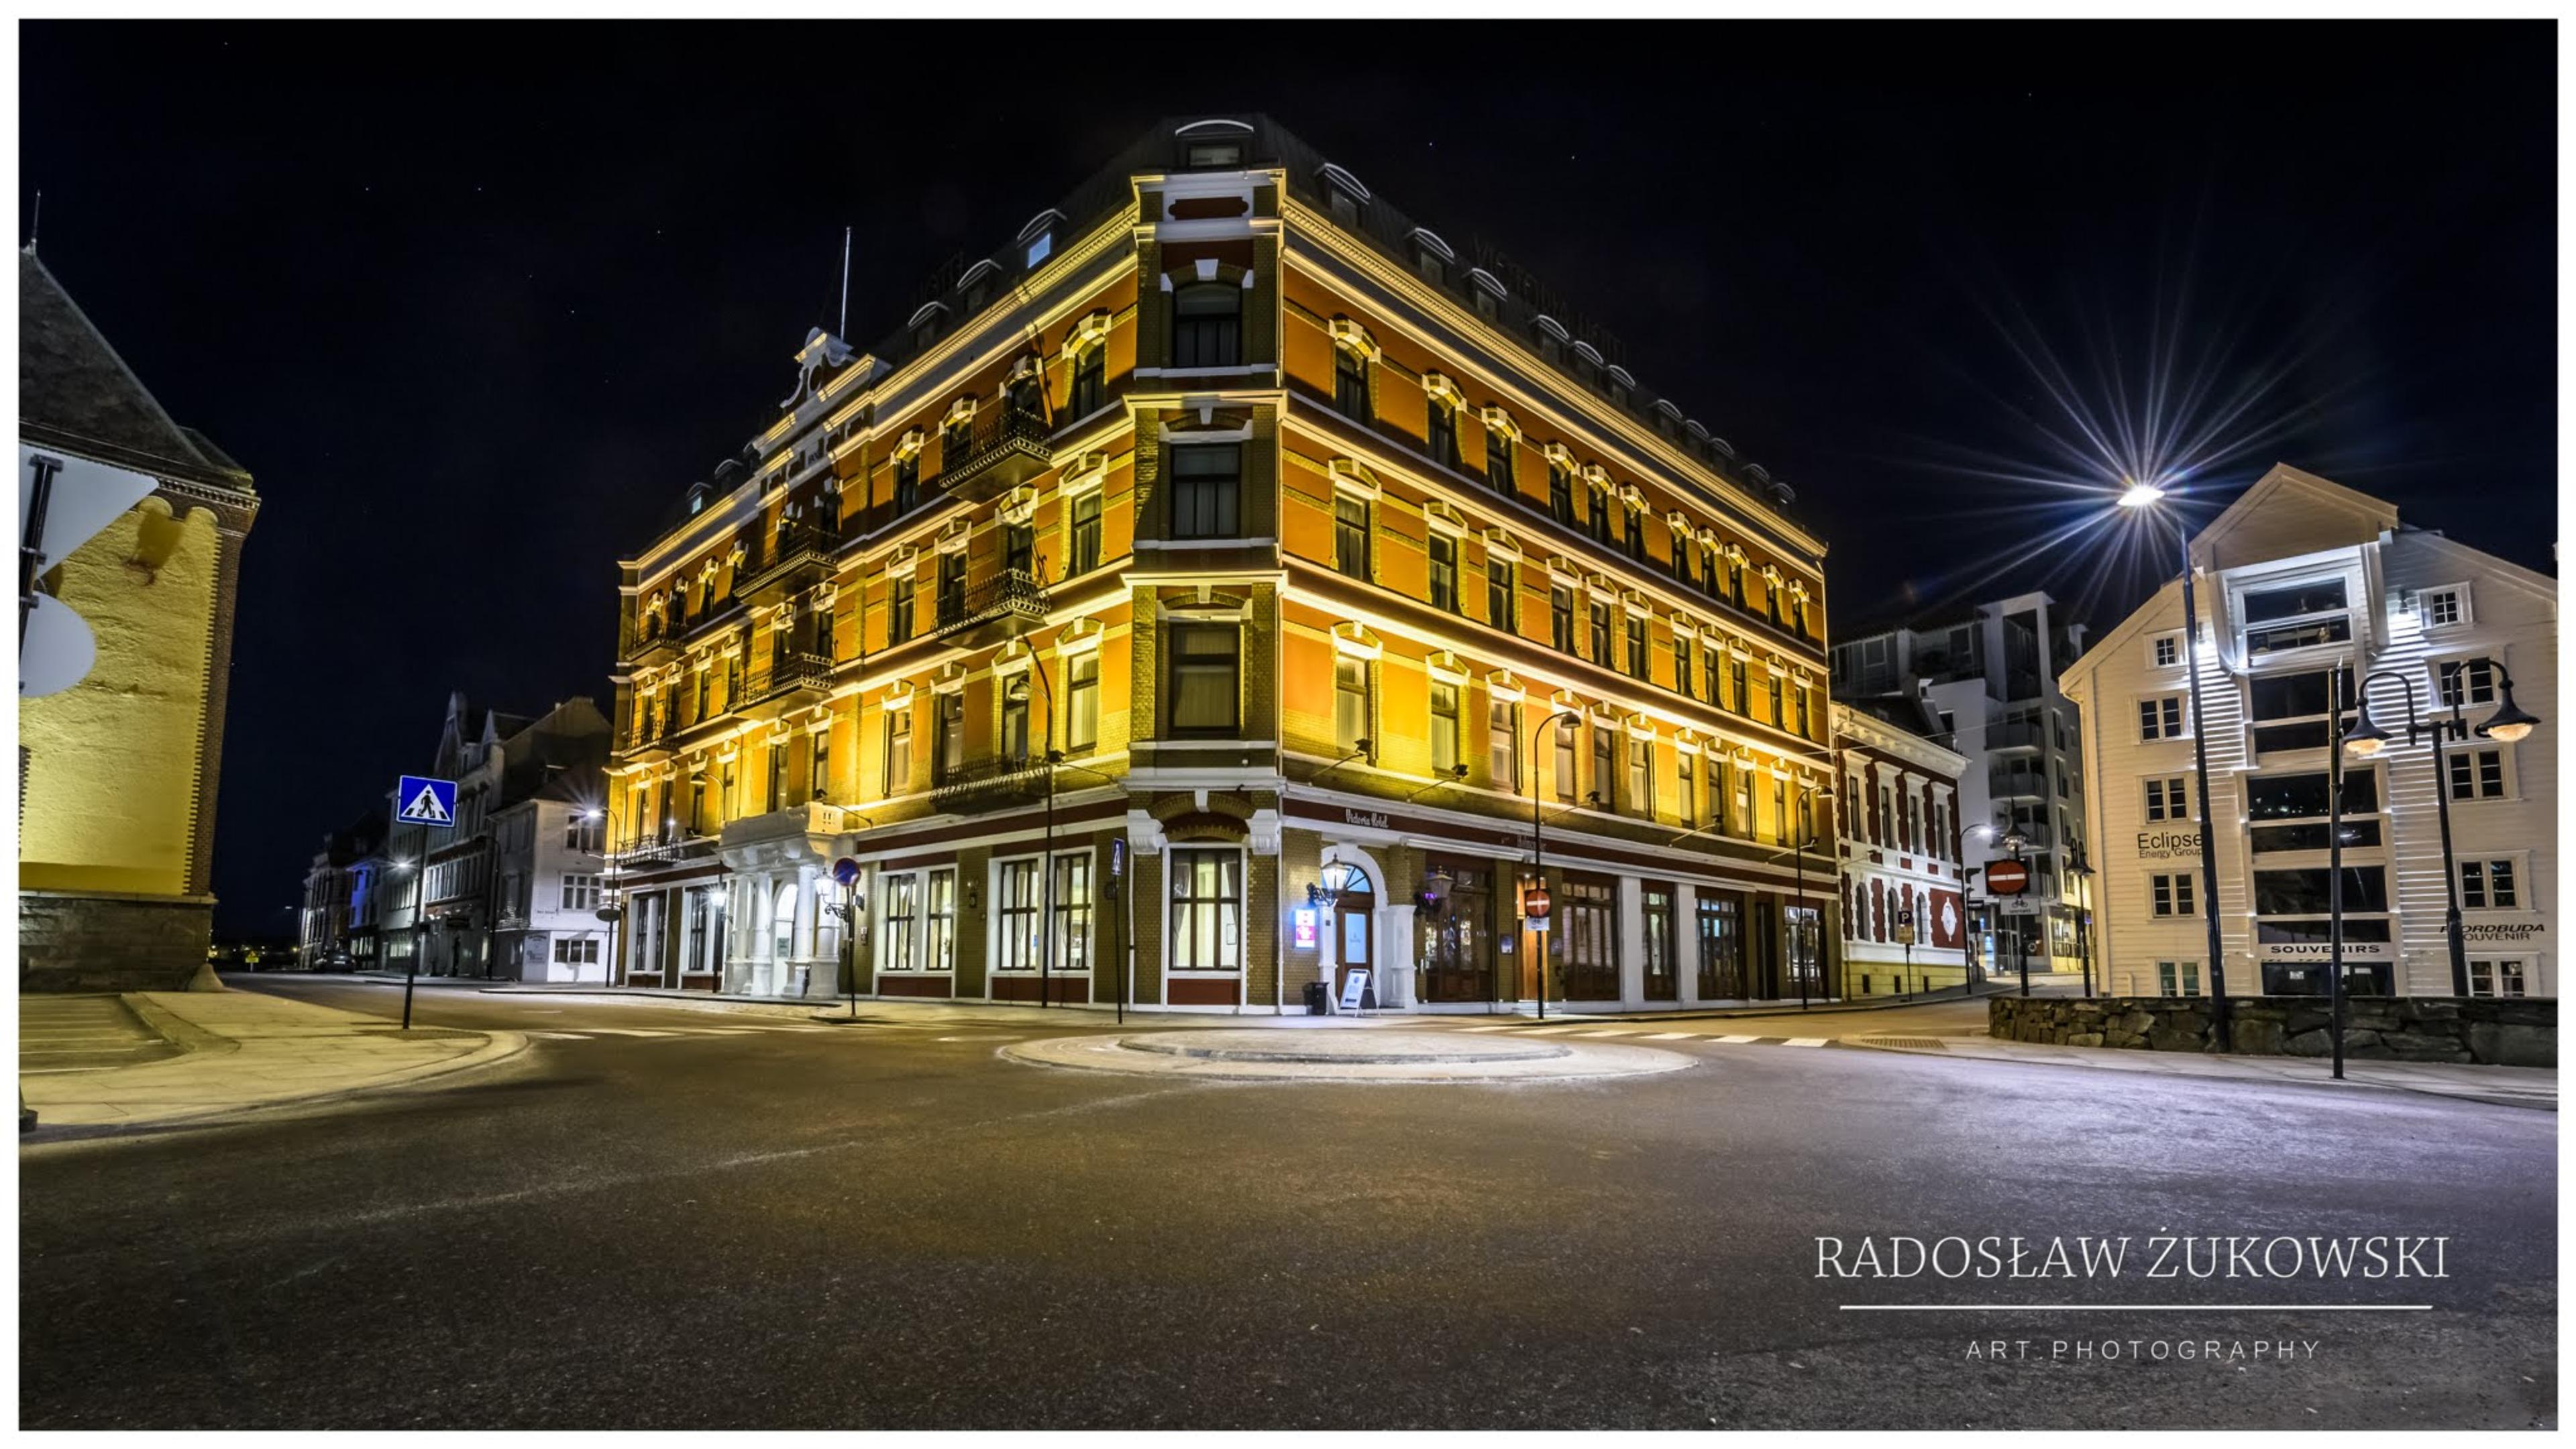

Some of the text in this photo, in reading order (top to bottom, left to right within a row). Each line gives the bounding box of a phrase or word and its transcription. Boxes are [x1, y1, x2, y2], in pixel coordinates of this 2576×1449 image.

[1346, 808, 1371, 826] Victoria
[2137, 832, 2202, 851] Eclipse
[2139, 847, 2203, 859] Energy Group
[1902, 912, 1909, 923] P
[2440, 924, 2545, 932] FORDBUDA
[2463, 932, 2530, 941] OUVENIR
